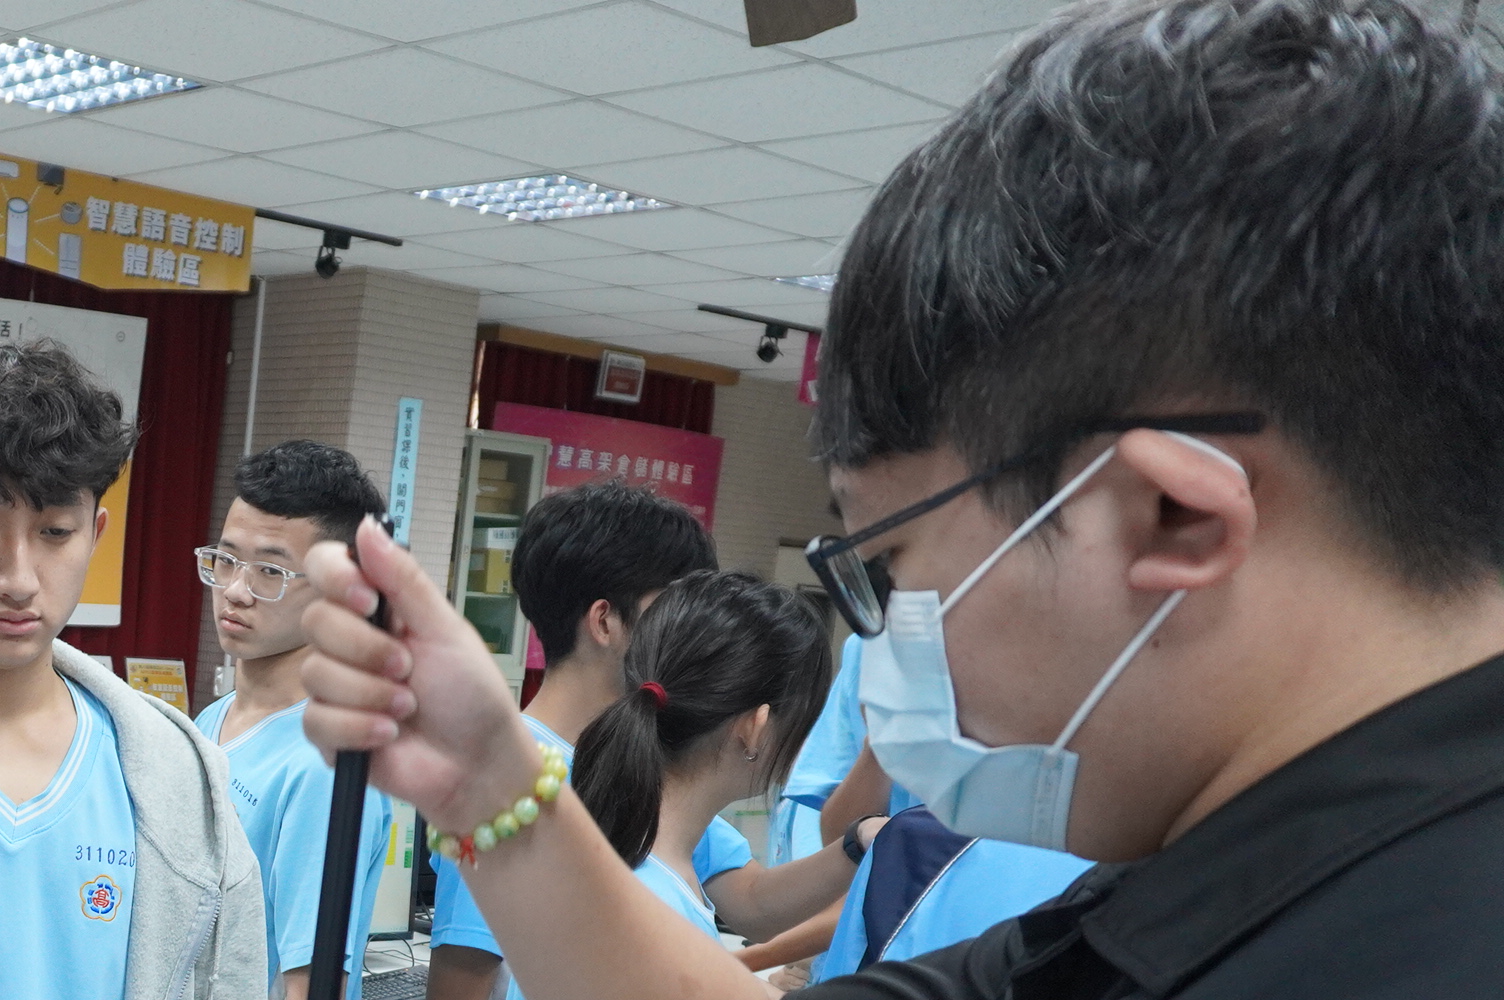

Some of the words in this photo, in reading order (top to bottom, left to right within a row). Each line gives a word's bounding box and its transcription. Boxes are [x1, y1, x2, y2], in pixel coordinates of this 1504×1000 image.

[86, 195, 245, 258] 智慧語音控制
[122, 242, 202, 288] 體驗區
[549, 443, 695, 486] 慧高架倉儲體驗區
[75, 845, 135, 868] 311020
